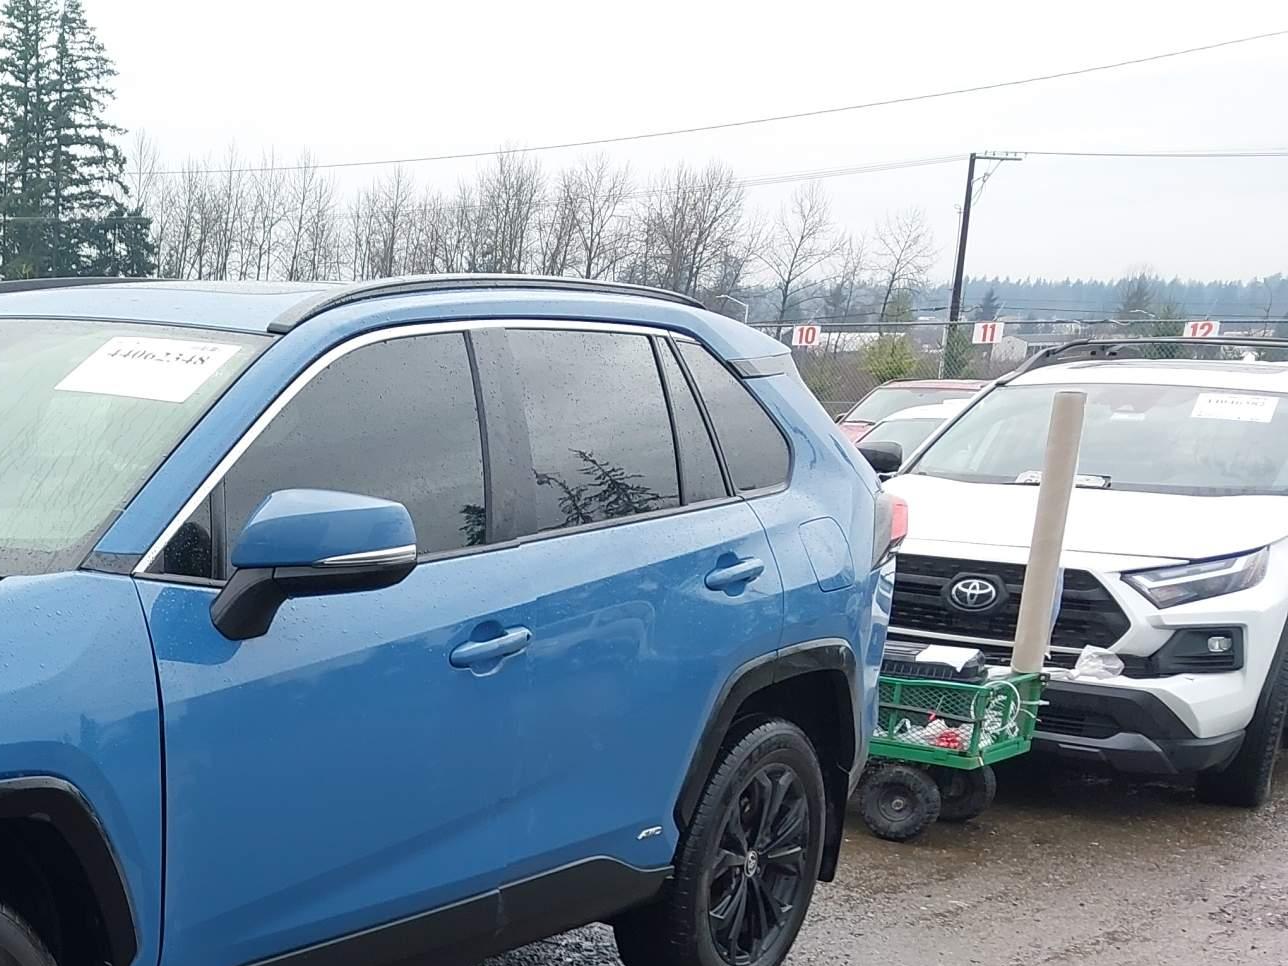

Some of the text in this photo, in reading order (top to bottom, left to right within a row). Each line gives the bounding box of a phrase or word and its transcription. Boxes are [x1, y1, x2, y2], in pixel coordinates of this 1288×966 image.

[797, 326, 816, 345] 10
[980, 323, 996, 342] 11
[1190, 322, 1214, 337] 12
